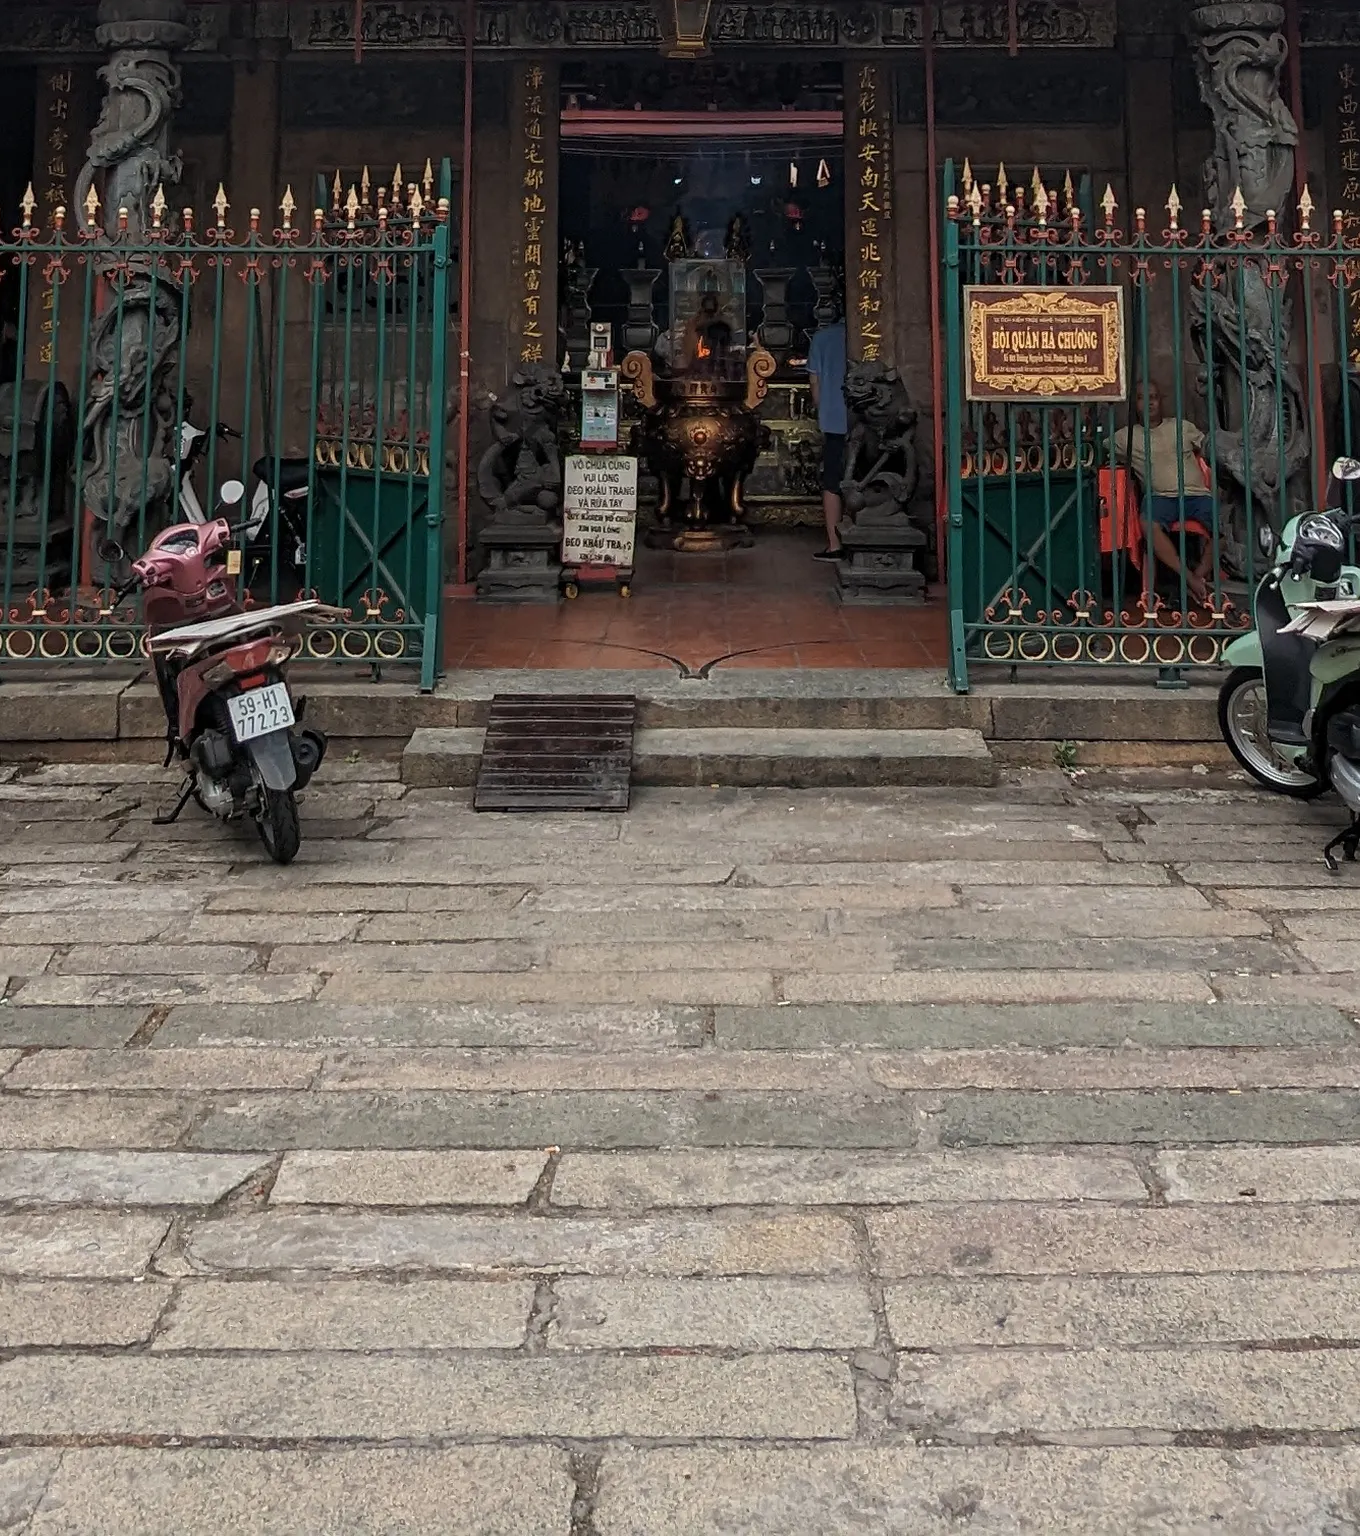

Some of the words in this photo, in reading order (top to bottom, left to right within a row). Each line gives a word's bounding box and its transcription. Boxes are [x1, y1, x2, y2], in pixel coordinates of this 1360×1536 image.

[992, 326, 1010, 353] HỘI
[1011, 326, 1040, 353] QUÁN
[1057, 327, 1098, 349] CHƯƠNG
[608, 486, 635, 495] TRANG
[609, 499, 624, 507] TAY
[238, 689, 279, 716] 59-H1
[238, 706, 290, 737] 772.23
